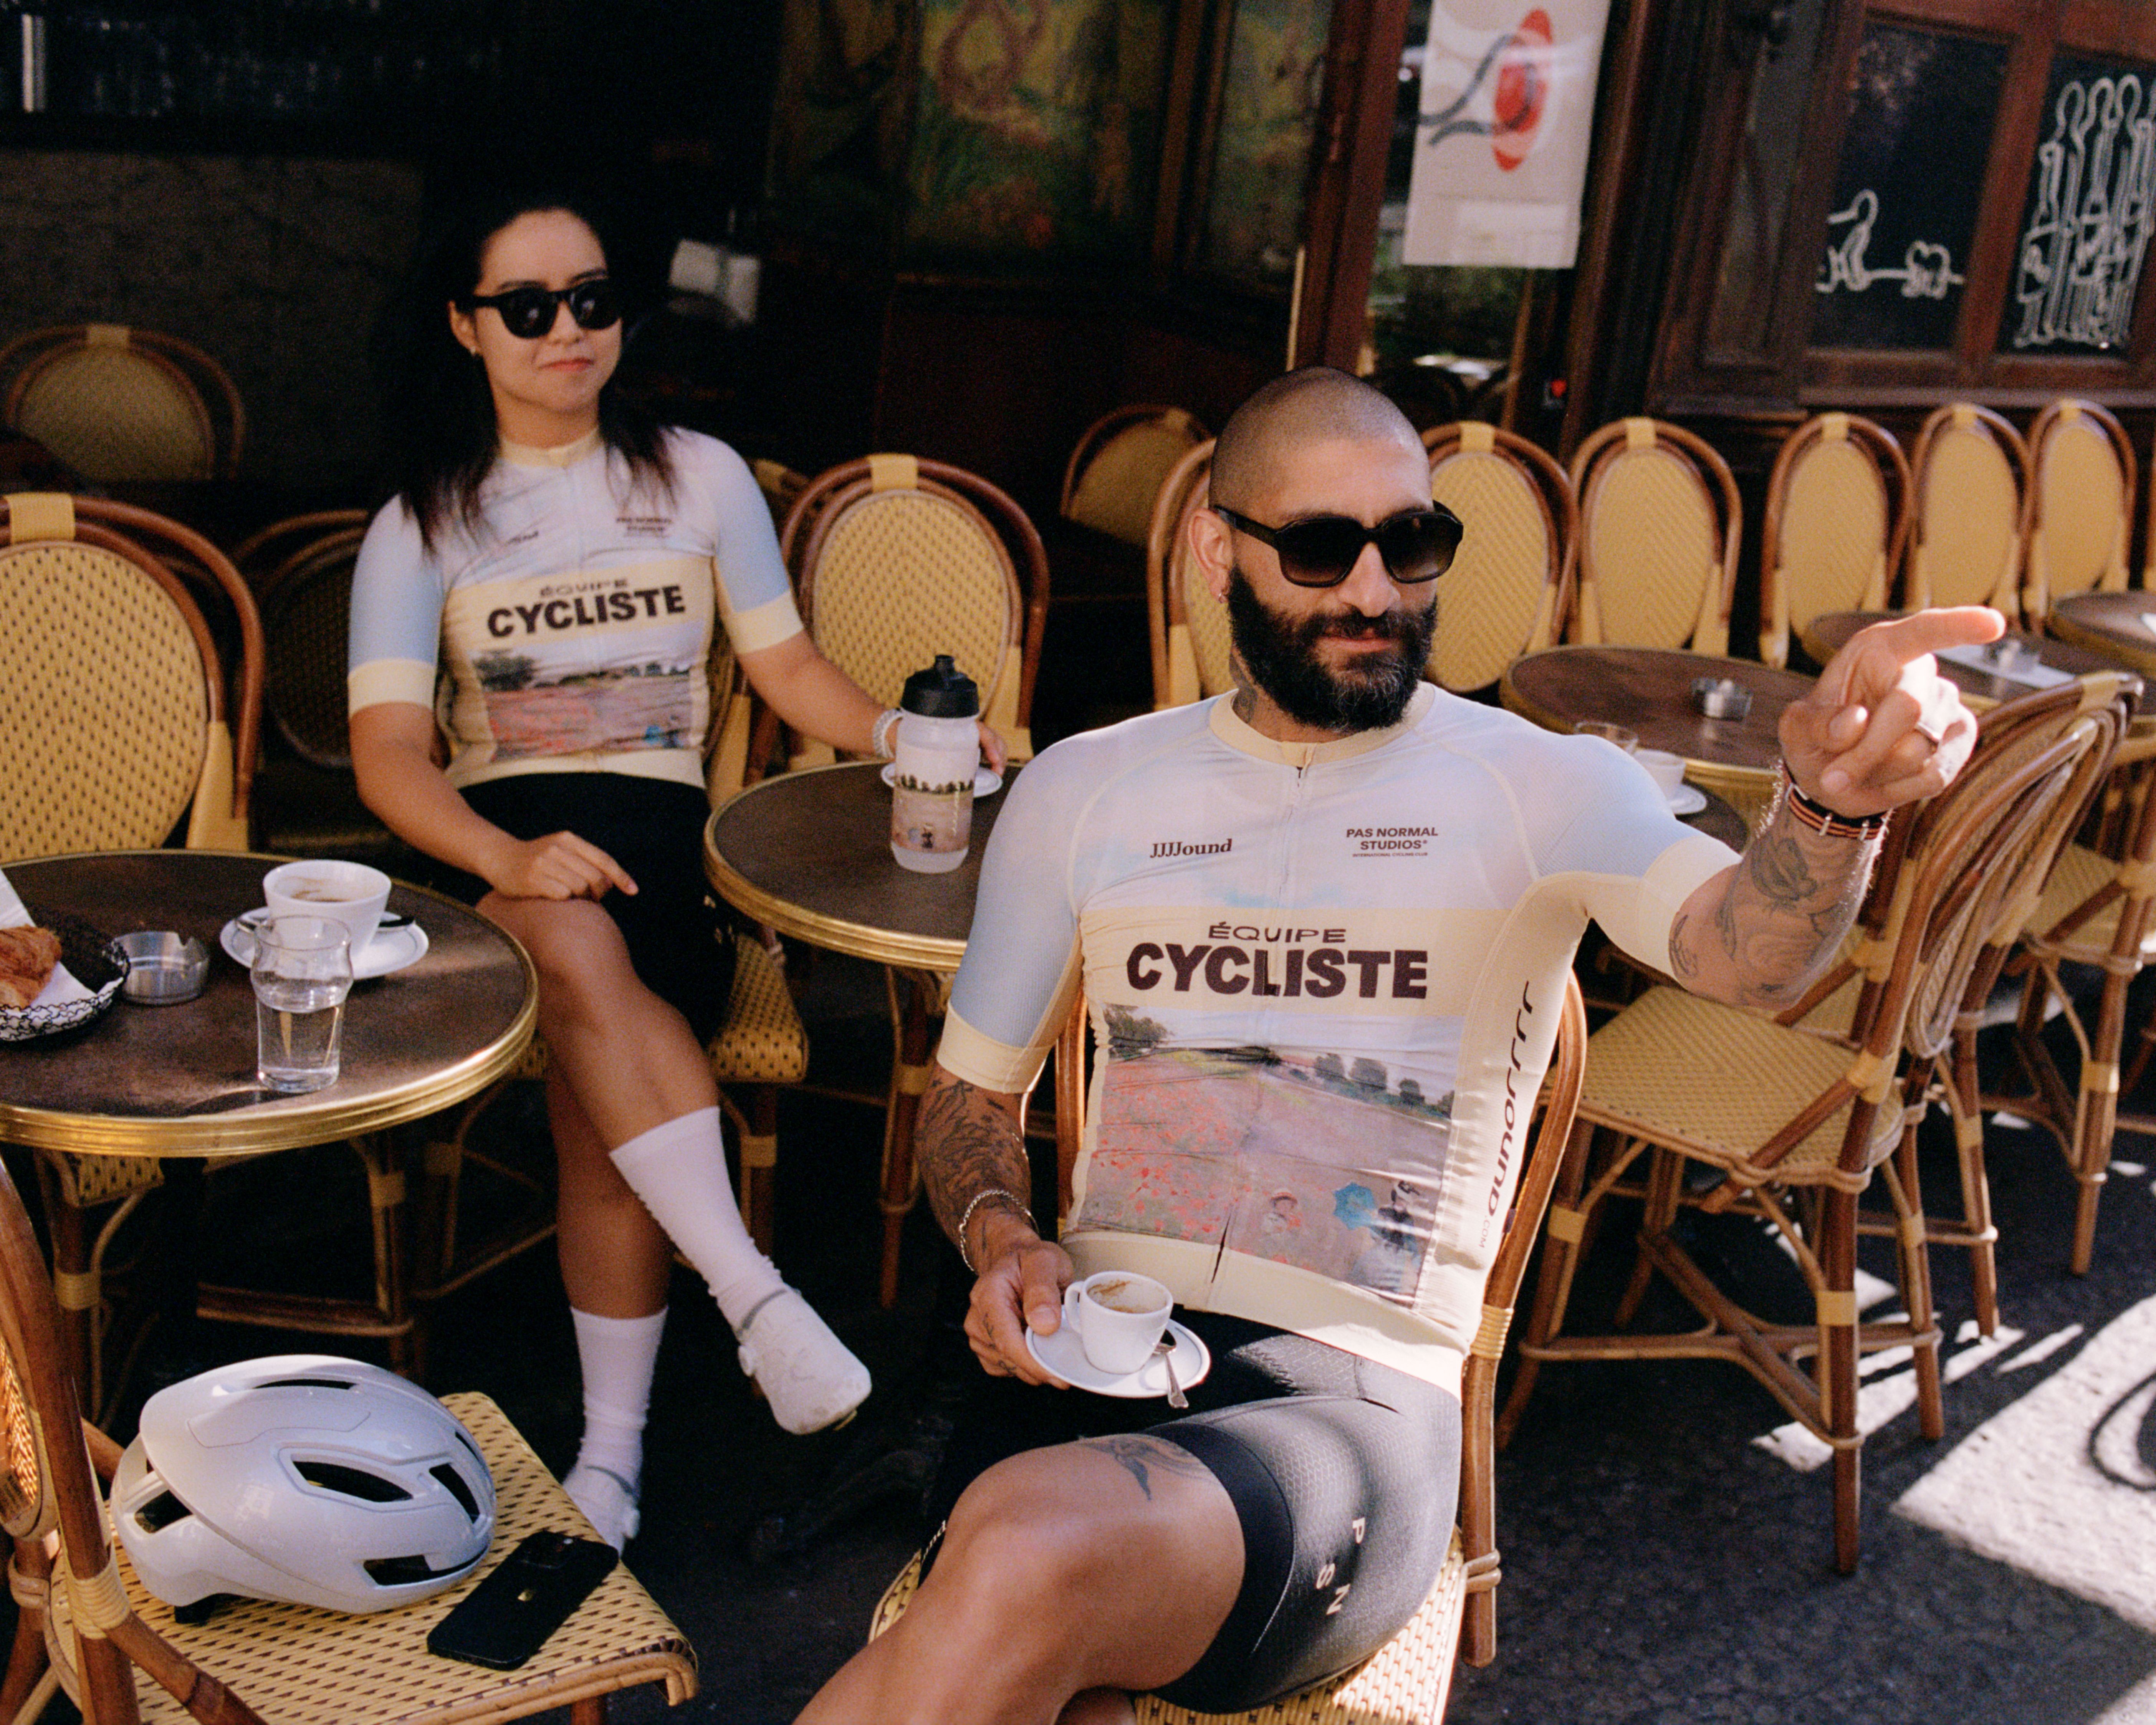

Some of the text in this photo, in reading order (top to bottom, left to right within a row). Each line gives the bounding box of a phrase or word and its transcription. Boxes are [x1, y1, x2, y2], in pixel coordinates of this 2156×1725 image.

[487, 585, 685, 638] CYCLISTE
[1346, 827, 1438, 838] PAS NORMAL
[1150, 838, 1232, 858] JJJJound
[1208, 921, 1346, 943] ÉQUIPE
[1126, 942, 1428, 999] CYCLISTE
